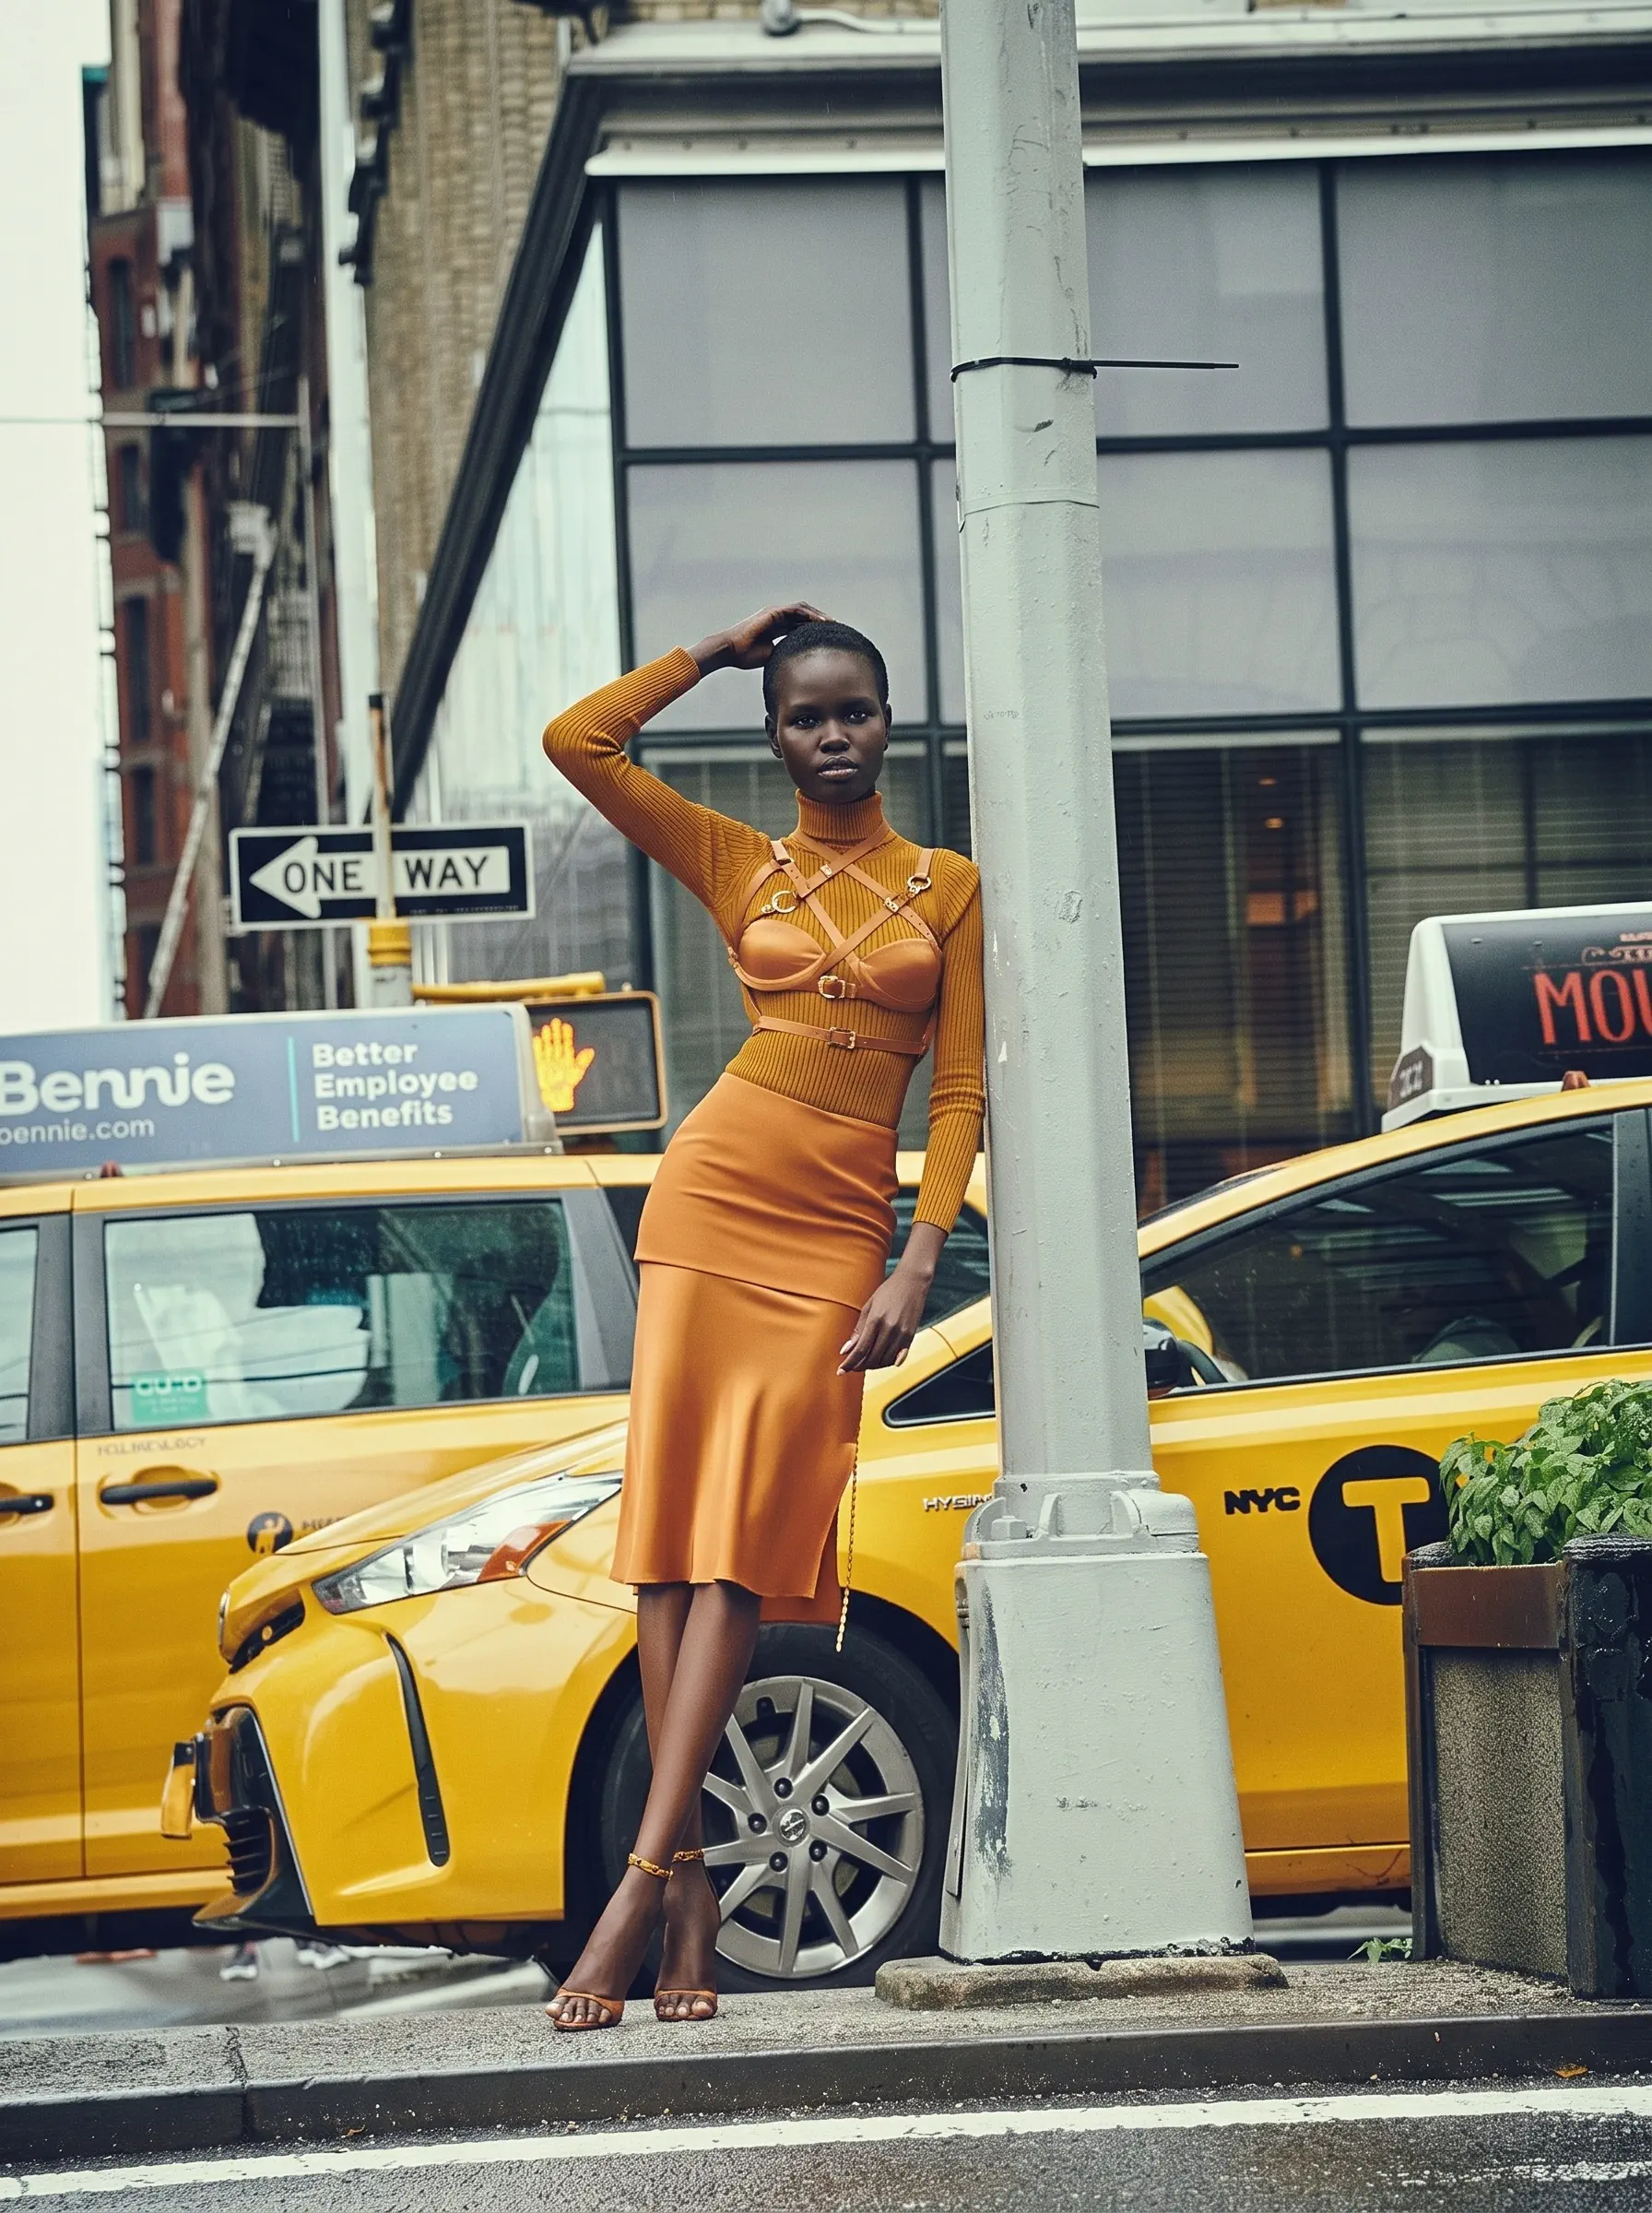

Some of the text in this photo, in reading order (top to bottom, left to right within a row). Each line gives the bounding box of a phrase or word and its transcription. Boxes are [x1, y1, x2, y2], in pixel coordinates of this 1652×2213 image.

[282, 855, 488, 894] ONE WAY
[313, 1042, 419, 1069] Better
[0, 1051, 235, 1117] Bennie
[314, 1069, 478, 1101] Employee
[317, 1099, 454, 1131] Benefits
[1223, 1476, 1431, 1583] NYC T
